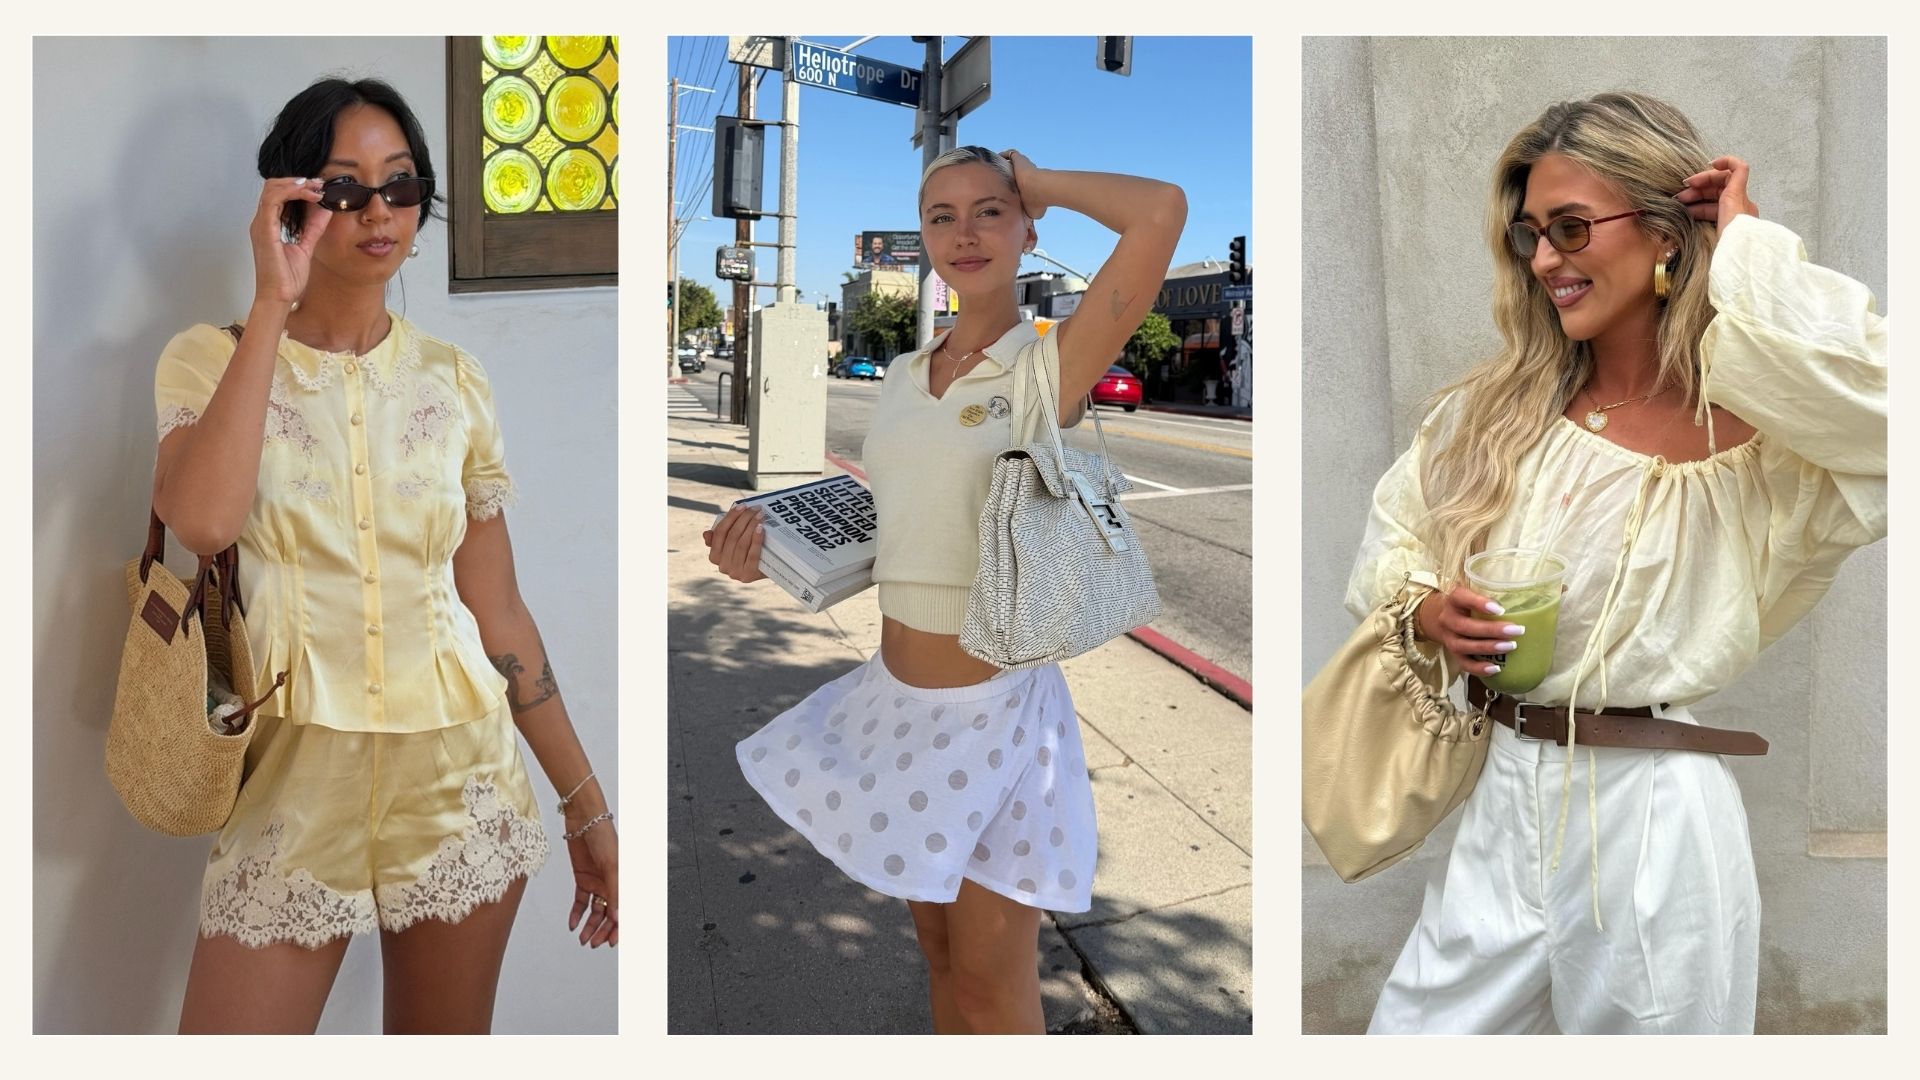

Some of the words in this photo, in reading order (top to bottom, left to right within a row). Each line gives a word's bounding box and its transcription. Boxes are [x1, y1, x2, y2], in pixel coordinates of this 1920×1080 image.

[799, 45, 884, 84] Heliotrope
[900, 69, 918, 91] Dr
[799, 66, 823, 83] 600
[828, 73, 837, 87] N
[1156, 288, 1173, 308] OF
[1177, 283, 1221, 307] LOVE
[829, 484, 873, 513] LITTLE
[842, 480, 861, 489] IT
[768, 500, 836, 551] 1919-2002
[782, 495, 852, 545] PRODUCTS
[799, 491, 873, 543] CHAMPION
[814, 488, 877, 531] SELECTED
